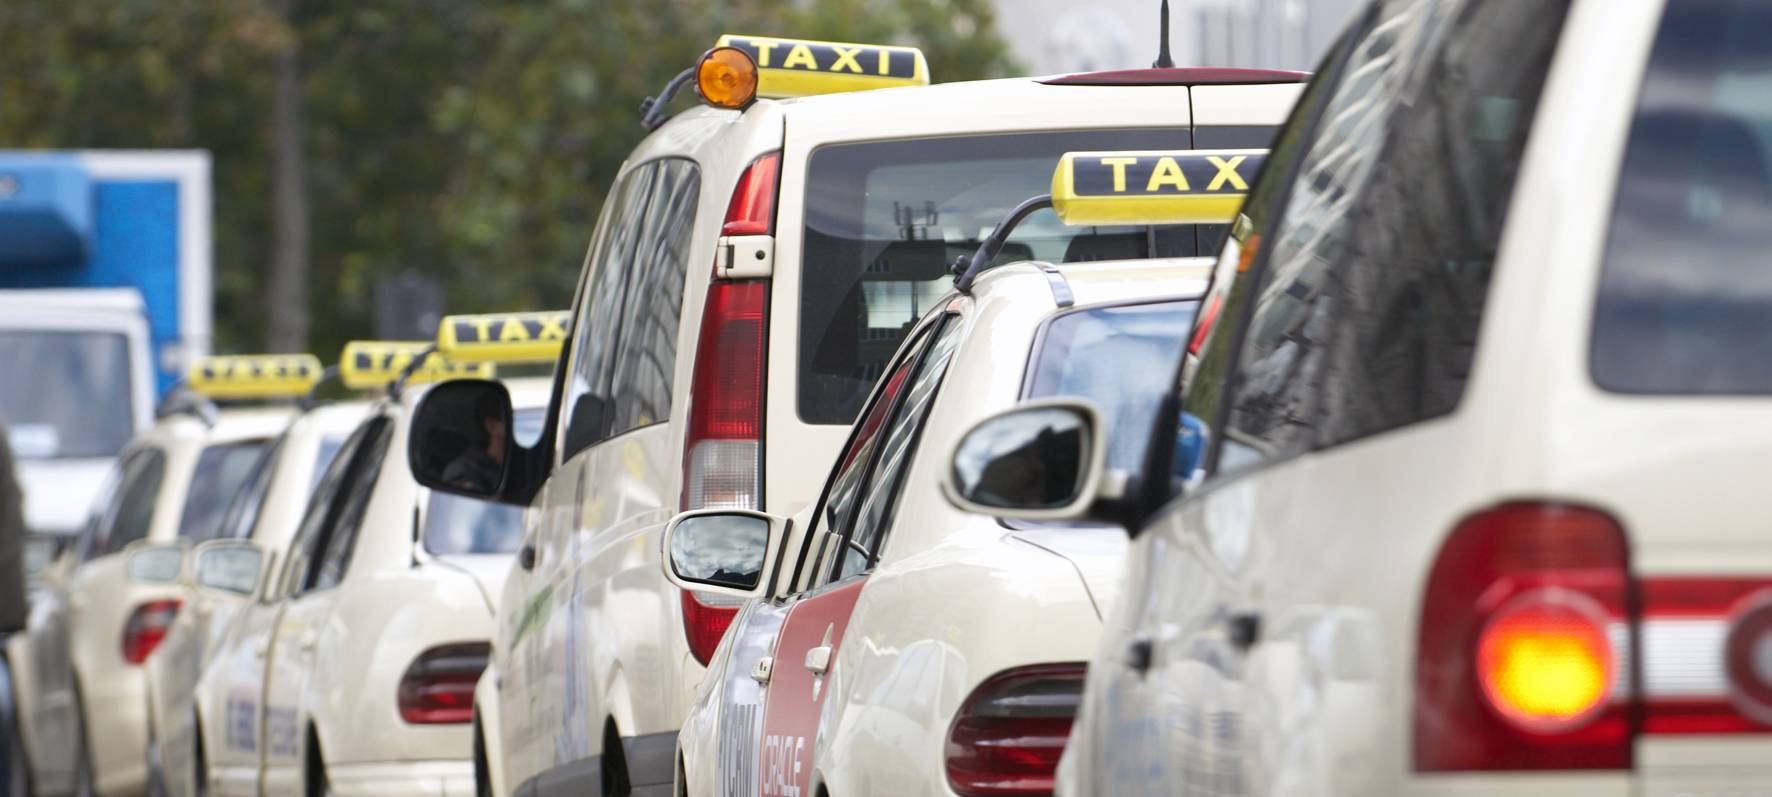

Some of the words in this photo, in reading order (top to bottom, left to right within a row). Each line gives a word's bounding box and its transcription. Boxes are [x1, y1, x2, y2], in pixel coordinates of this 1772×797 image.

[750, 41, 891, 75] TAXI
[1101, 156, 1249, 192] TAX
[469, 317, 567, 342] TAX
[763, 734, 806, 797] ORACLE
